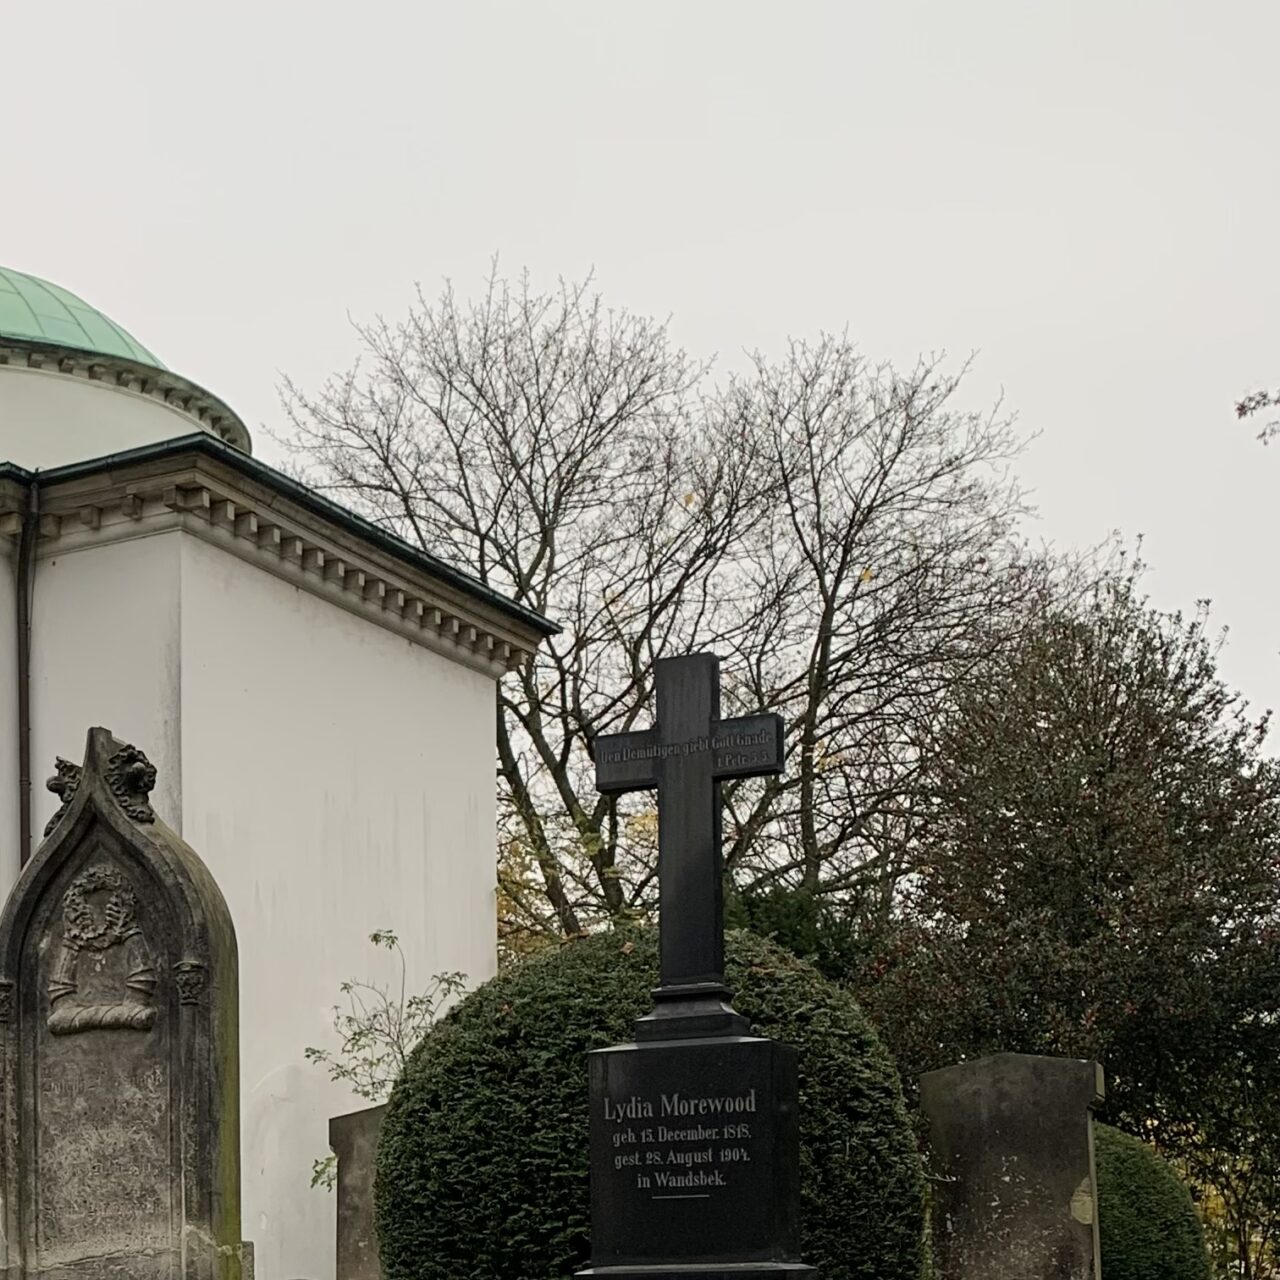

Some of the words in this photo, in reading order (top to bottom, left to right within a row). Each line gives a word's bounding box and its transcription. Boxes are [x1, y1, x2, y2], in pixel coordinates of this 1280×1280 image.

[711, 735, 734, 749] Gott
[604, 1096, 654, 1123] Lydia
[661, 1089, 756, 1117] Morewood
[612, 1128, 637, 1147] geb.
[640, 1130, 655, 1143] 15.
[657, 1124, 720, 1142] December.
[723, 1123, 752, 1139] 1818.
[614, 1151, 642, 1169] gest.
[646, 1151, 664, 1165] 28.
[666, 1148, 713, 1168] August
[637, 1173, 650, 1188] in
[654, 1170, 727, 1188] Wandsbek.
